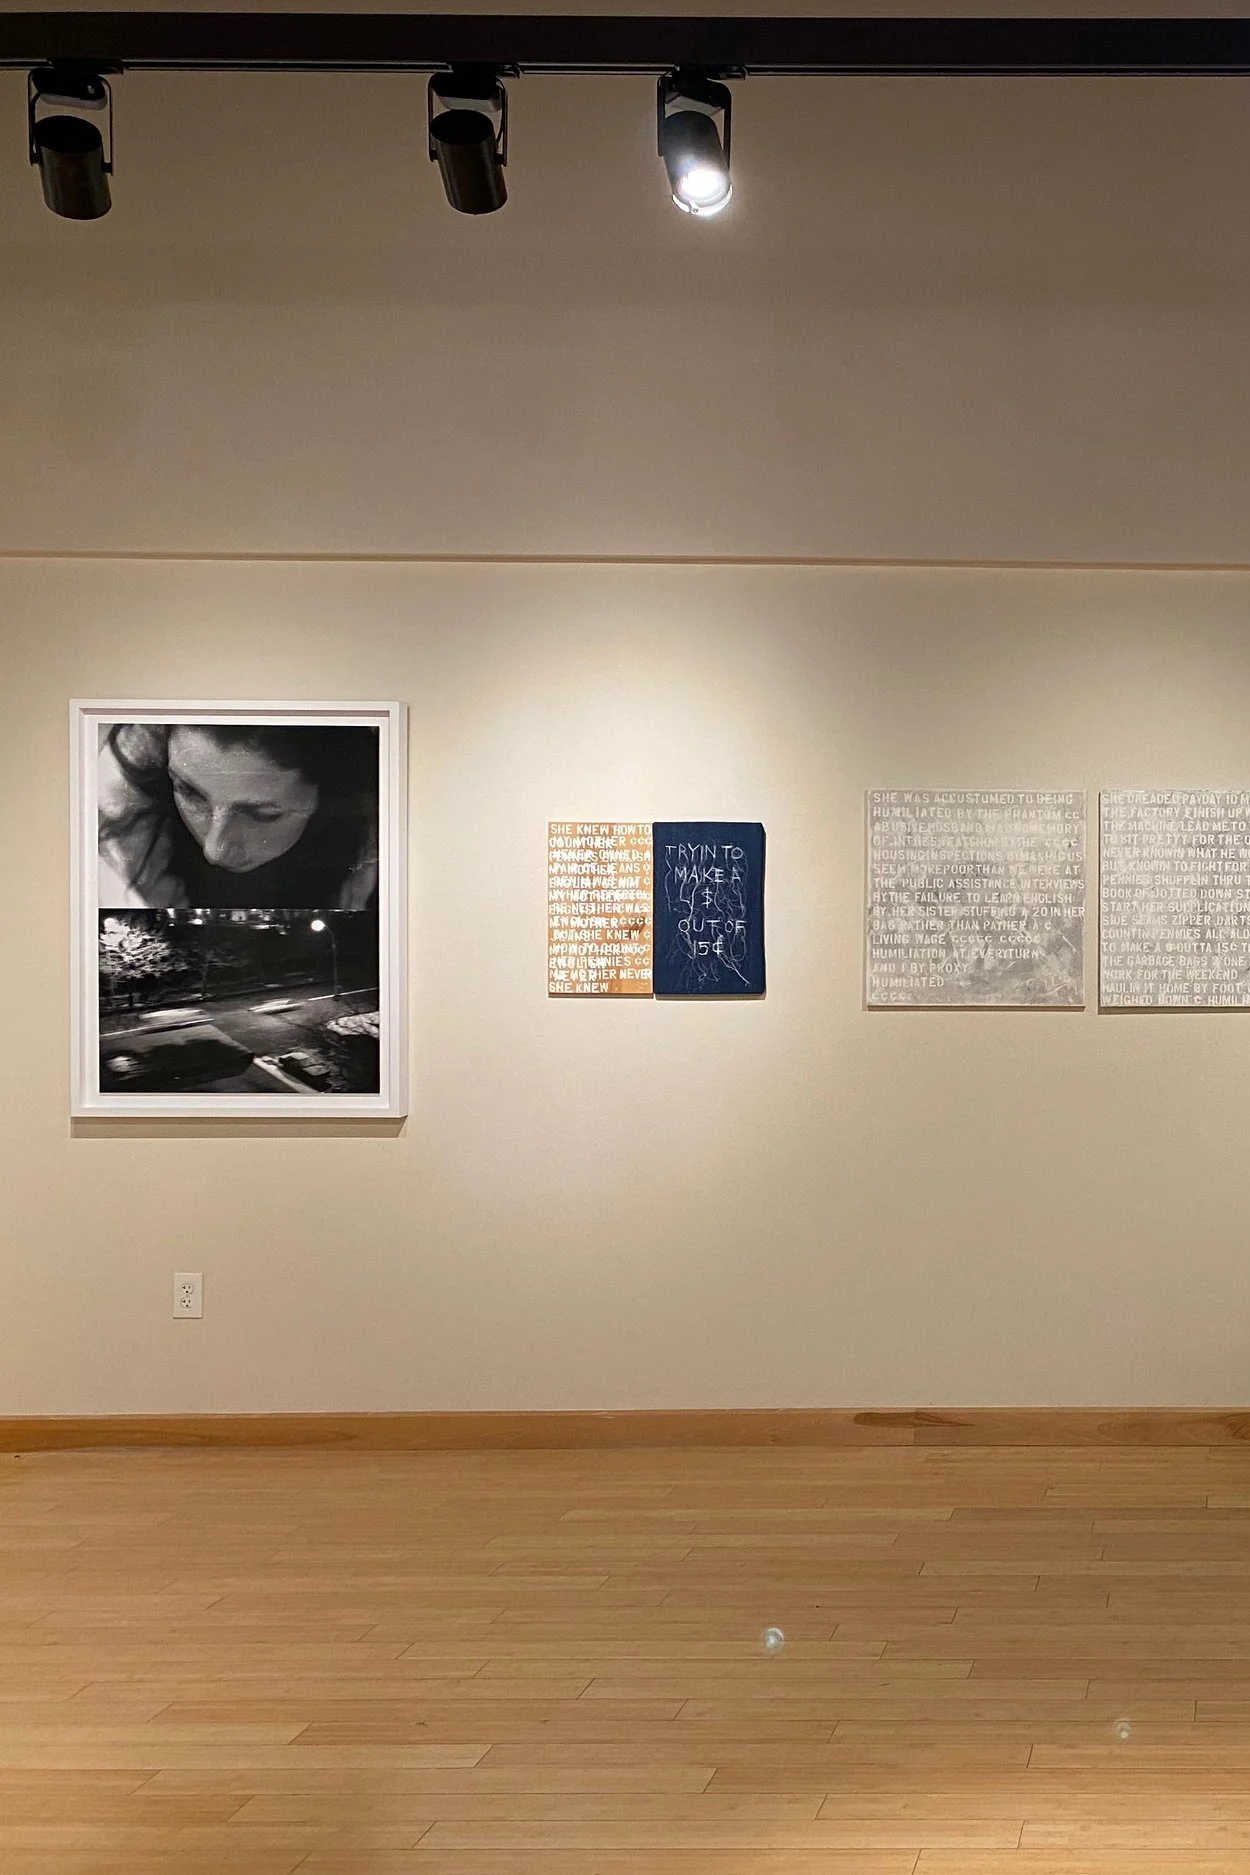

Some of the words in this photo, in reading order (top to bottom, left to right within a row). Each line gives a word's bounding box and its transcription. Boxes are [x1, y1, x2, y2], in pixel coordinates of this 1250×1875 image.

[873, 794, 897, 804] SHE
[904, 794, 929, 804] WAS
[934, 794, 1014, 804] ACCUSTOMED
[1018, 794, 1032, 804] TO
[1183, 794, 1222, 805] PAYDAY
[873, 807, 949, 819] HUMILIATED
[957, 807, 972, 819] BY
[977, 807, 999, 819] THE
[1004, 807, 1061, 819] PHANTOM
[1228, 807, 1241, 818] UP
[551, 824, 572, 834] SHE
[577, 824, 609, 835] KNEW
[613, 824, 636, 835] HOW
[637, 825, 651, 835] TO
[1181, 821, 1209, 831] LEAD
[1213, 821, 1230, 831] ME
[1231, 821, 1245, 831] TO
[1193, 834, 1214, 845] FOR
[1218, 834, 1240, 845] THE
[665, 843, 716, 861] TRYIN
[721, 845, 743, 859] TO
[1188, 848, 1218, 859] WHAT
[1221, 848, 1235, 859] HE
[944, 865, 974, 875] POOR
[976, 865, 1004, 875] THAN
[1065, 865, 1079, 875] AT
[1175, 861, 1187, 872] TO
[1225, 861, 1246, 872] FOR
[674, 865, 724, 883] MAKE
[731, 867, 741, 883] A
[874, 878, 895, 889] THE
[903, 878, 943, 889] PUBLIC
[949, 878, 1015, 889] ASSISTANCE
[1020, 878, 1084, 889] INTERVIEWS
[1213, 875, 1241, 885] THRU
[701, 886, 713, 908] $
[914, 892, 958, 903] FAILURE
[967, 892, 979, 903] TO
[1023, 892, 1072, 903] ENGLISH
[1103, 888, 1131, 899] BOOK
[1200, 888, 1231, 899] DOWN
[919, 907, 957, 917] SISTER
[963, 907, 1015, 917] STUFFING
[1021, 907, 1029, 917] A
[1033, 907, 1048, 917] 20
[1051, 907, 1060, 917] IN
[1065, 907, 1085, 917] HER
[1103, 902, 1138, 912] START
[1142, 902, 1163, 912] HER
[678, 918, 720, 933] OUT
[725, 919, 747, 933] OF
[950, 921, 979, 930] THAN
[1172, 915, 1210, 925] ZIPPER
[606, 930, 639, 940] KNEW
[873, 935, 909, 944] LIVING
[915, 935, 945, 944] WAGE
[1155, 929, 1200, 939] PENNIES
[1206, 929, 1225, 939] ALL
[1122, 943, 1149, 953] MAKE
[1177, 943, 1211, 953] OUTTA
[873, 949, 945, 959] HUMILIATION
[1103, 956, 1122, 967] THE
[1128, 956, 1175, 967] GARBAGE
[1179, 956, 1207, 967] BAGS
[1224, 956, 1245, 967] ONE
[873, 963, 895, 973] AND
[911, 963, 924, 973] BY
[929, 963, 967, 973] PROXY
[1137, 970, 1157, 980] FOR
[1187, 970, 1237, 980] WEEKEND
[549, 982, 572, 993] SHE
[576, 983, 608, 993] KNEW
[872, 977, 944, 988] HUMILIATED
[1194, 983, 1208, 993] BY
[1213, 983, 1240, 993] FOOT
